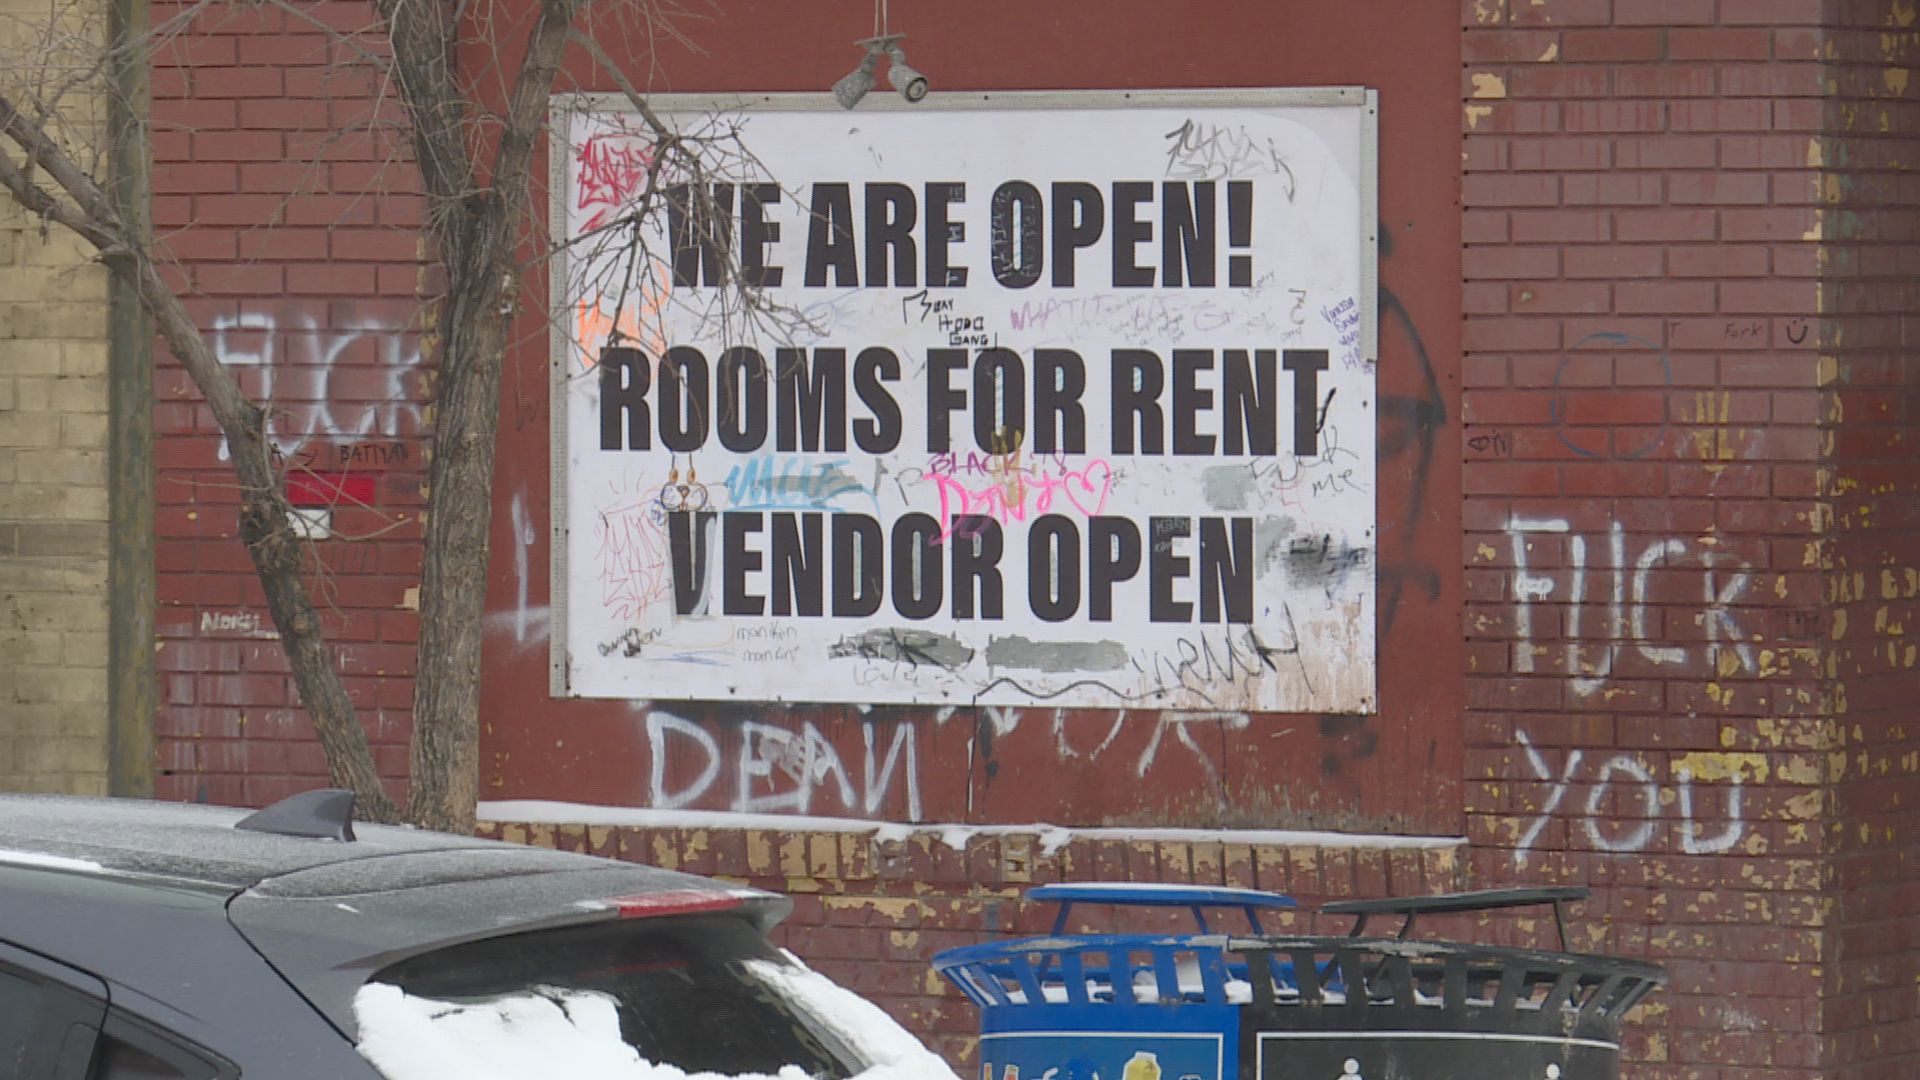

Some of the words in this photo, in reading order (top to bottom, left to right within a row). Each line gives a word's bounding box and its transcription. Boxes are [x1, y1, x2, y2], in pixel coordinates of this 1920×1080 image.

[669, 181, 783, 288] WE
[804, 182, 968, 287] ARE
[991, 180, 1253, 288] OPEN!
[598, 345, 902, 453] ROOMS
[926, 346, 1087, 453] FOR
[1110, 348, 1331, 455] RENT
[668, 510, 1004, 619] VENDOR
[1027, 513, 1254, 622] OPEN
[1504, 514, 1756, 697] FUCK
[1515, 728, 1744, 864] YOU
